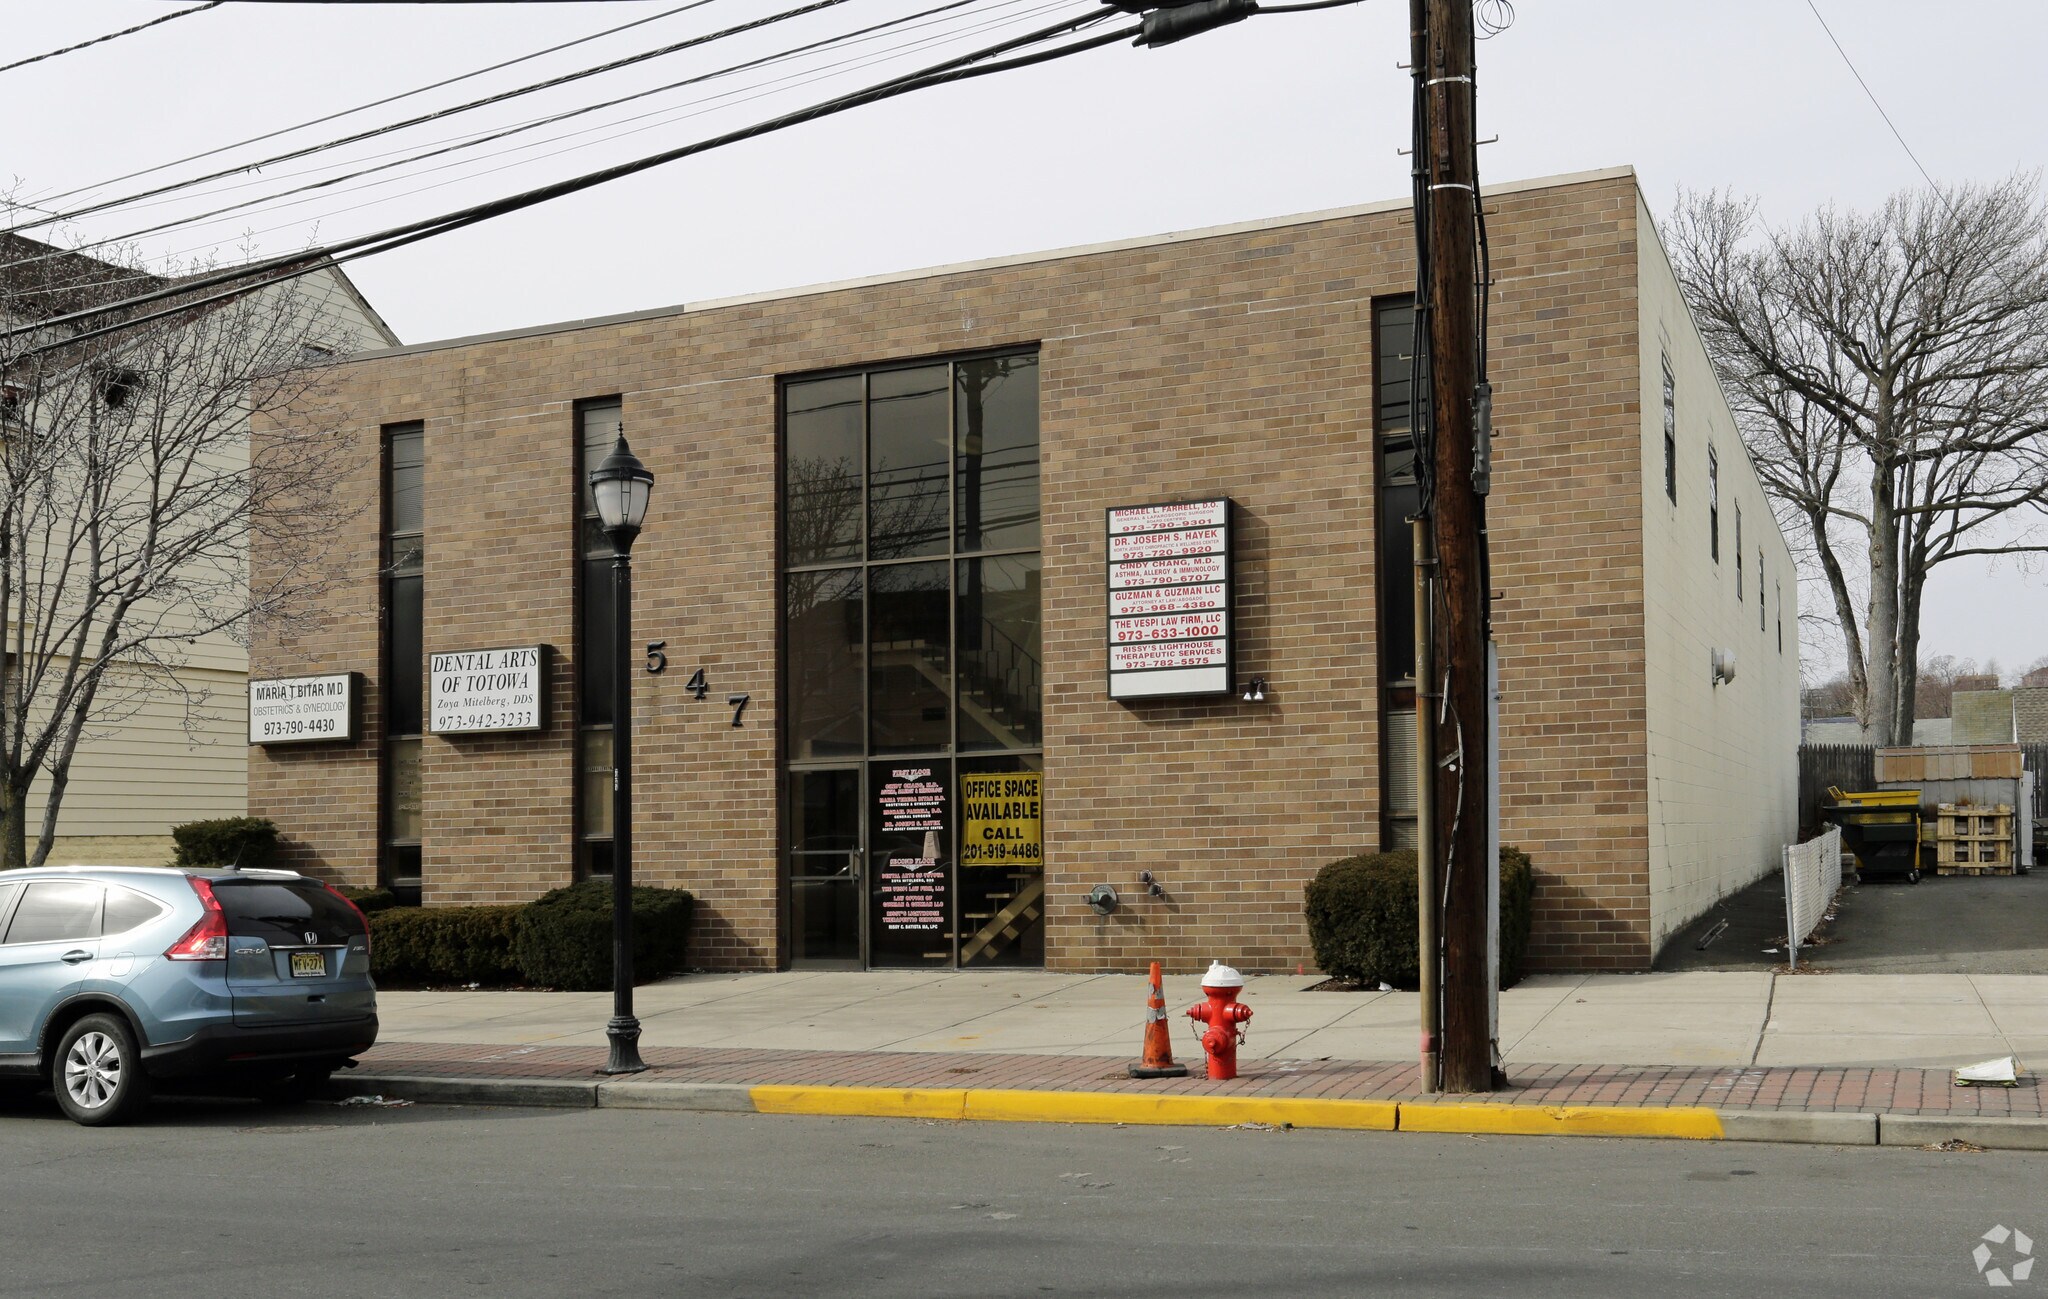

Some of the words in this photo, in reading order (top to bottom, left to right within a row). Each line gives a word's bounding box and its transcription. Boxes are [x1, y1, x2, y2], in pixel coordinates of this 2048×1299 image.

[1114, 508, 1150, 517] MICHAEL
[1162, 503, 1200, 513] FARRELL,
[1122, 518, 1212, 532] 973-790-9301
[1114, 538, 1130, 546] DR.
[1133, 534, 1170, 545] JOSEPH
[1174, 533, 1182, 541] S.
[1185, 530, 1218, 540] HAYEK
[1122, 546, 1212, 559] 973-720-9920
[1120, 561, 1148, 570] CINDY
[1179, 565, 1220, 574] IMMUNOLOGY
[1124, 574, 1210, 586] 973-790-6707
[1115, 590, 1152, 600] GUZMAN
[1155, 590, 1161, 598] &
[1164, 587, 1202, 597] GUZMAN
[1205, 585, 1221, 594] LLC
[1121, 601, 1215, 613] 973-968-4380
[1115, 620, 1131, 629] THE
[1134, 619, 1158, 628] VESPI
[1161, 617, 1178, 626] LAW
[1180, 615, 1204, 625] FIRM,
[1206, 614, 1221, 623] LLC
[1118, 625, 1219, 641] 973-633-1000
[1159, 642, 1214, 650] LIGHTHOUSE
[433, 653, 494, 673] DENTAL
[499, 649, 537, 669] ARTS
[1115, 651, 1175, 660] THERAPEUTIC
[1178, 648, 1222, 656] SERVICES
[1126, 657, 1209, 668] 973-782-5575
[442, 676, 461, 693] OF
[467, 672, 529, 692] TOTOWA
[256, 686, 287, 700] MARIA
[298, 684, 324, 698] BITAR
[253, 704, 294, 716] OBSTETRICS
[296, 704, 301, 714] &
[303, 701, 346, 713] GYNECOLOGY
[437, 699, 459, 711] Zoya
[463, 696, 510, 708] Mitelberg,
[513, 694, 533, 704] DDS
[264, 719, 335, 736] 973-790-4430
[439, 711, 532, 730] 973-942-3233
[966, 781, 1001, 798] OFFICE
[1005, 779, 1038, 797] SPACE
[967, 802, 1039, 820] AVAILABLE
[983, 827, 1023, 839] CALL
[964, 843, 1039, 859] 201-919-4486
